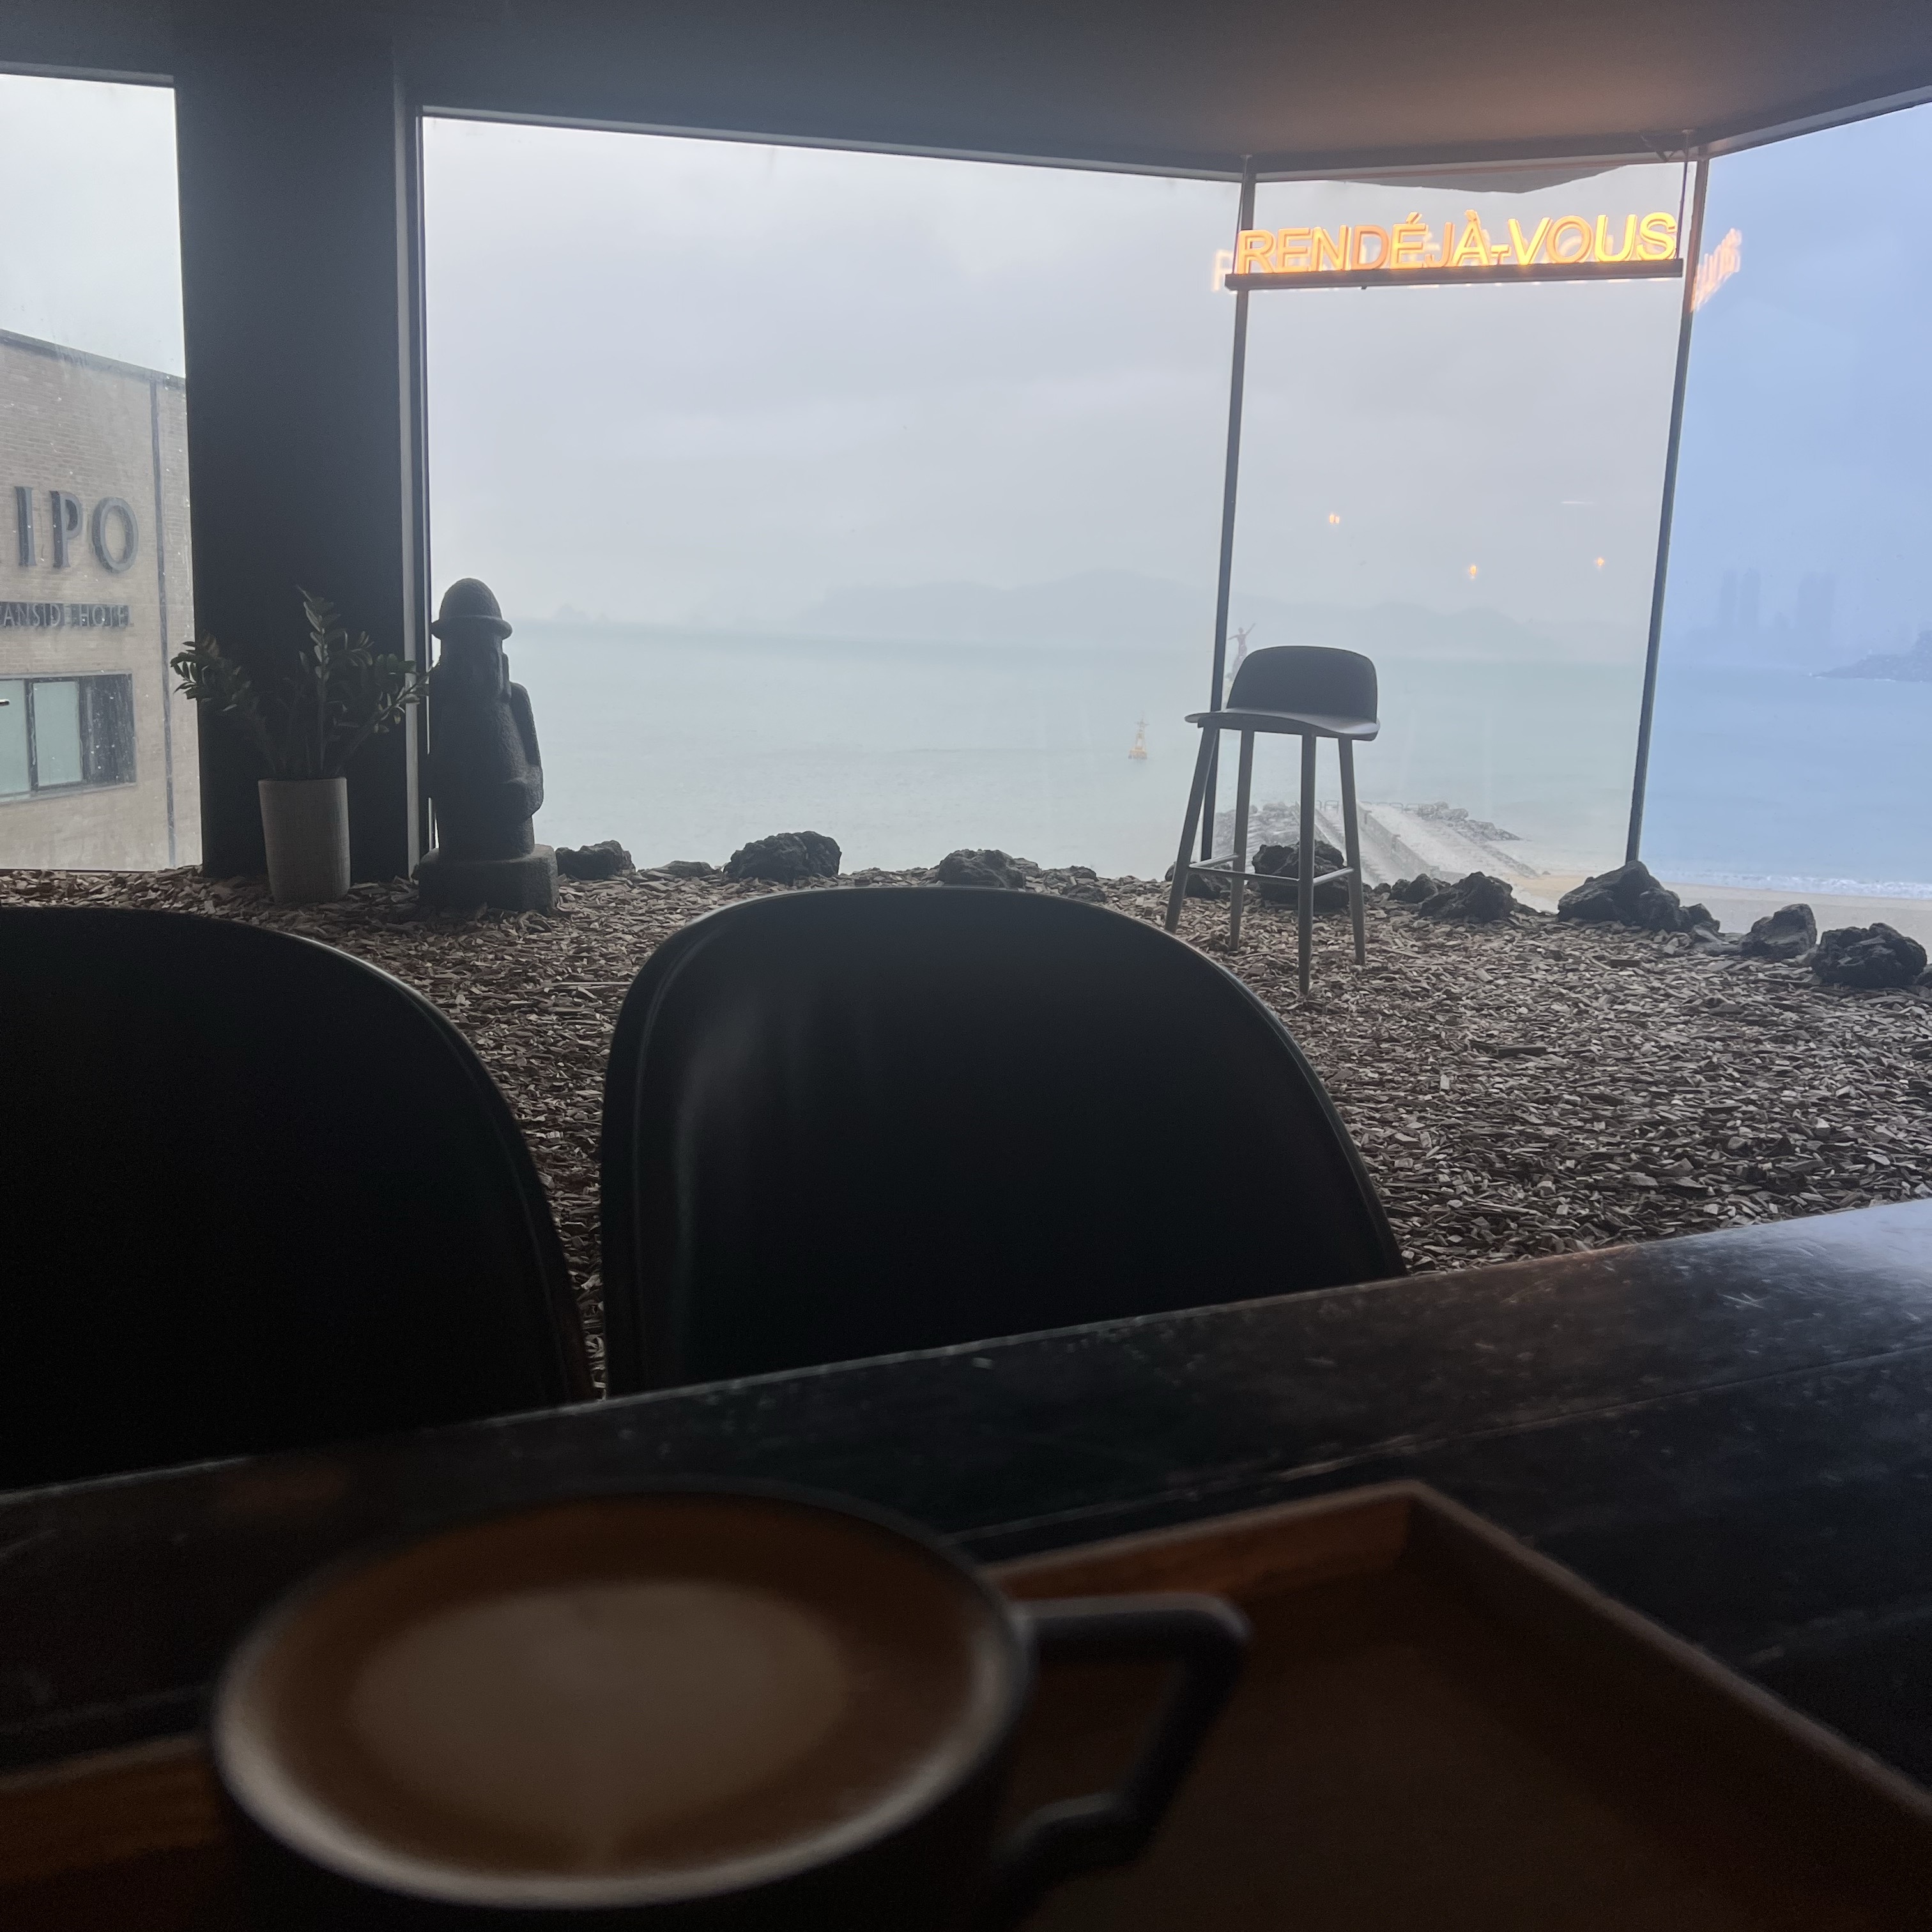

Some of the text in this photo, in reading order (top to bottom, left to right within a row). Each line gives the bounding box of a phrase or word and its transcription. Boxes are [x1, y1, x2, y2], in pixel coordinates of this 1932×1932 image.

[1236, 209, 1677, 274] RENDÉJÀ-VOUS
[14, 486, 139, 573] IPO
[77, 604, 134, 627] HOTEL
